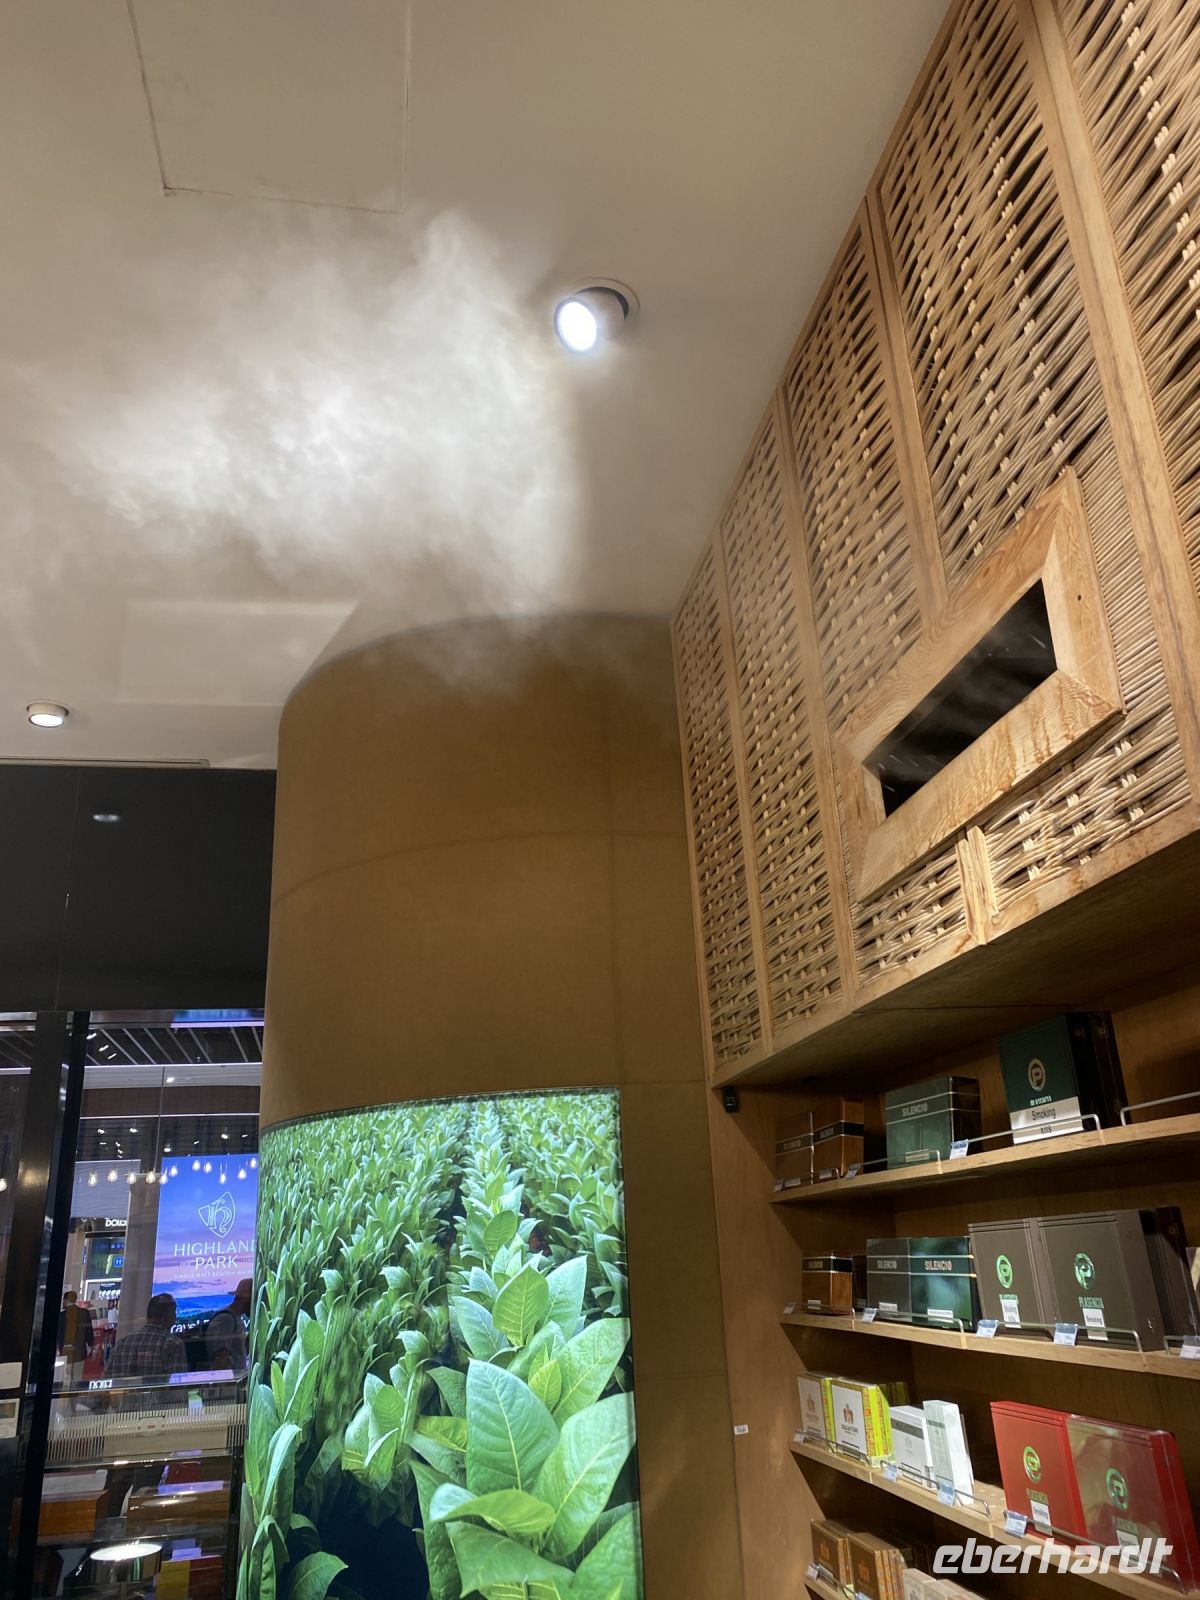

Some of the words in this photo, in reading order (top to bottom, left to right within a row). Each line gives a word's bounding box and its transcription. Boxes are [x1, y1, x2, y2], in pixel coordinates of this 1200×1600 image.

[902, 1103, 928, 1117] SILENCIO
[1032, 1108, 1057, 1121] Smoking
[195, 1255, 239, 1270] PARK
[924, 1260, 953, 1271] SILENCIO
